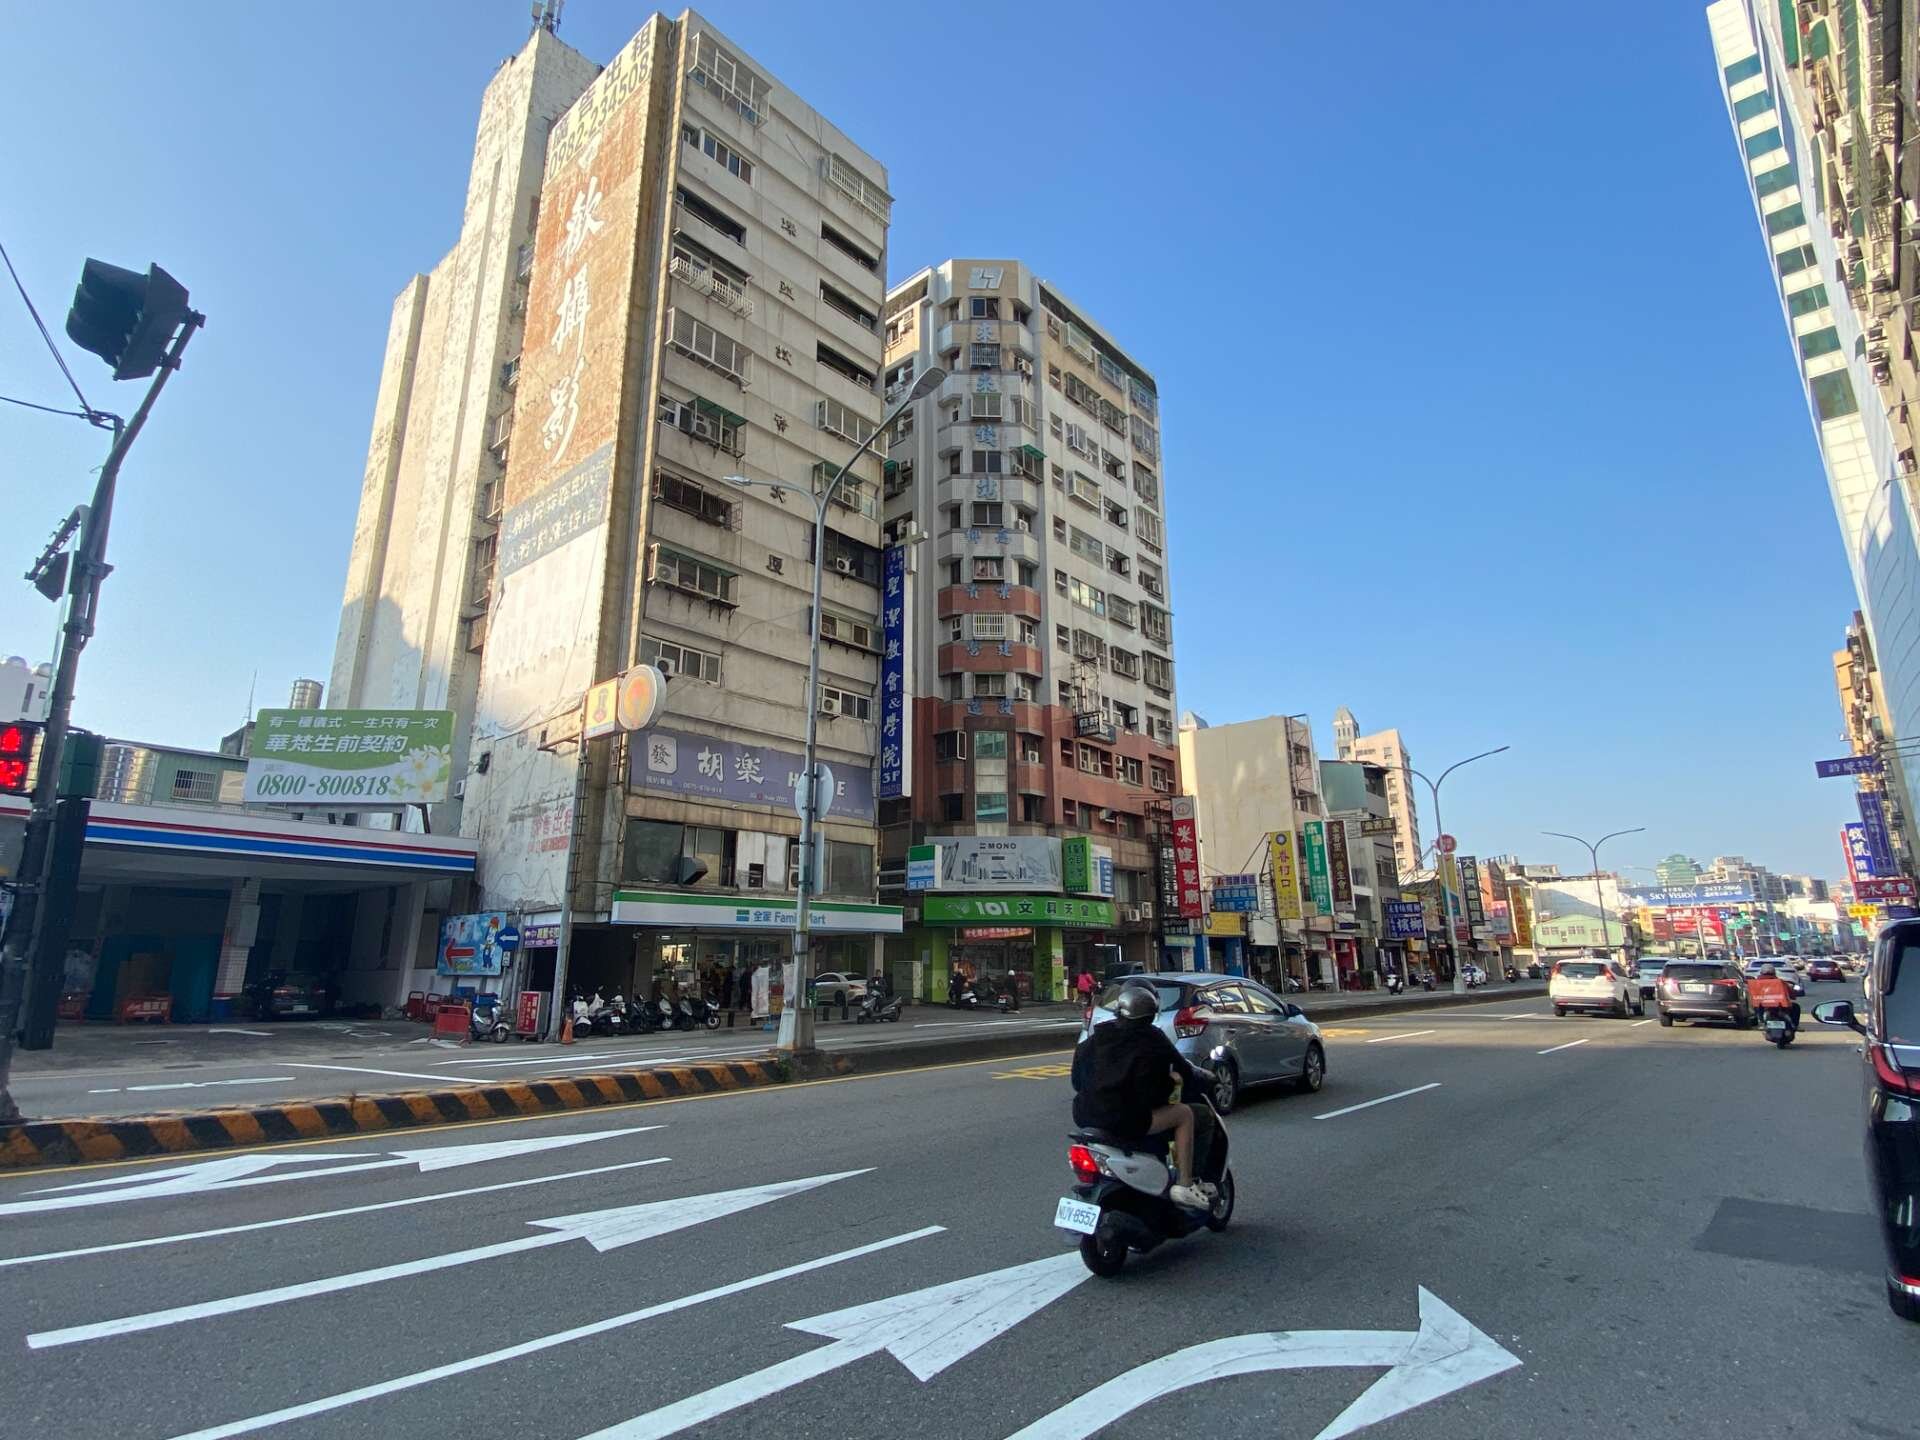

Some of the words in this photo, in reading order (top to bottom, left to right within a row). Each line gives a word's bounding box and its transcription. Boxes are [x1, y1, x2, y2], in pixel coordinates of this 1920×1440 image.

[651, 744, 672, 766] 發
[256, 774, 391, 796] 0800-800818
[988, 842, 1017, 850] MONO
[976, 902, 1010, 915] 101
[753, 910, 772, 923] 全家
